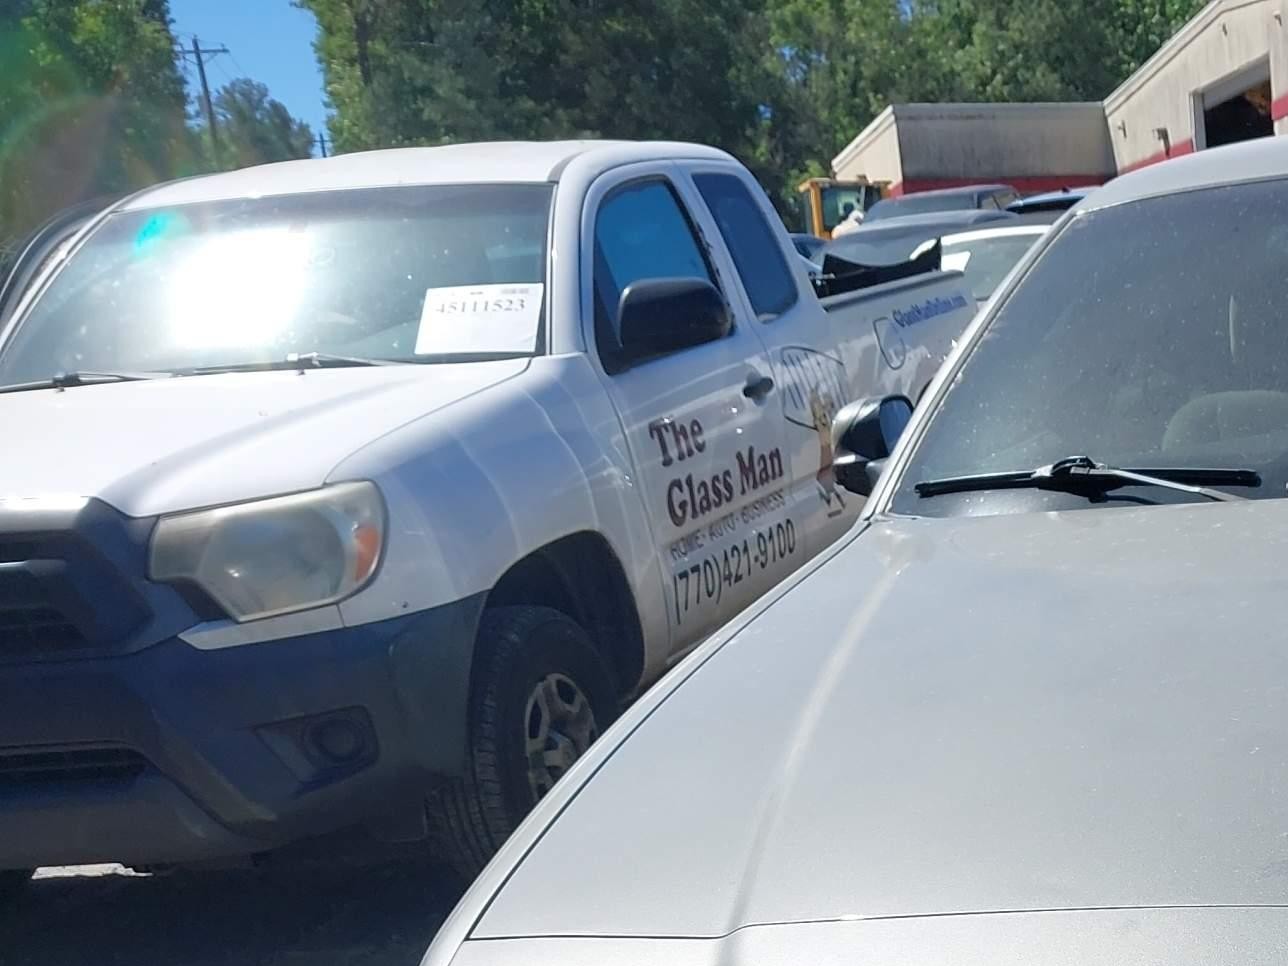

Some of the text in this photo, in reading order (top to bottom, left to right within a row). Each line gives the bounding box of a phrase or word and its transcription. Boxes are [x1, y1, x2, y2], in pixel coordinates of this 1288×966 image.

[435, 297, 526, 314] 45111523
[648, 417, 706, 467] The
[667, 445, 784, 527] Glass Man
[673, 517, 797, 626] (770)421-9100
